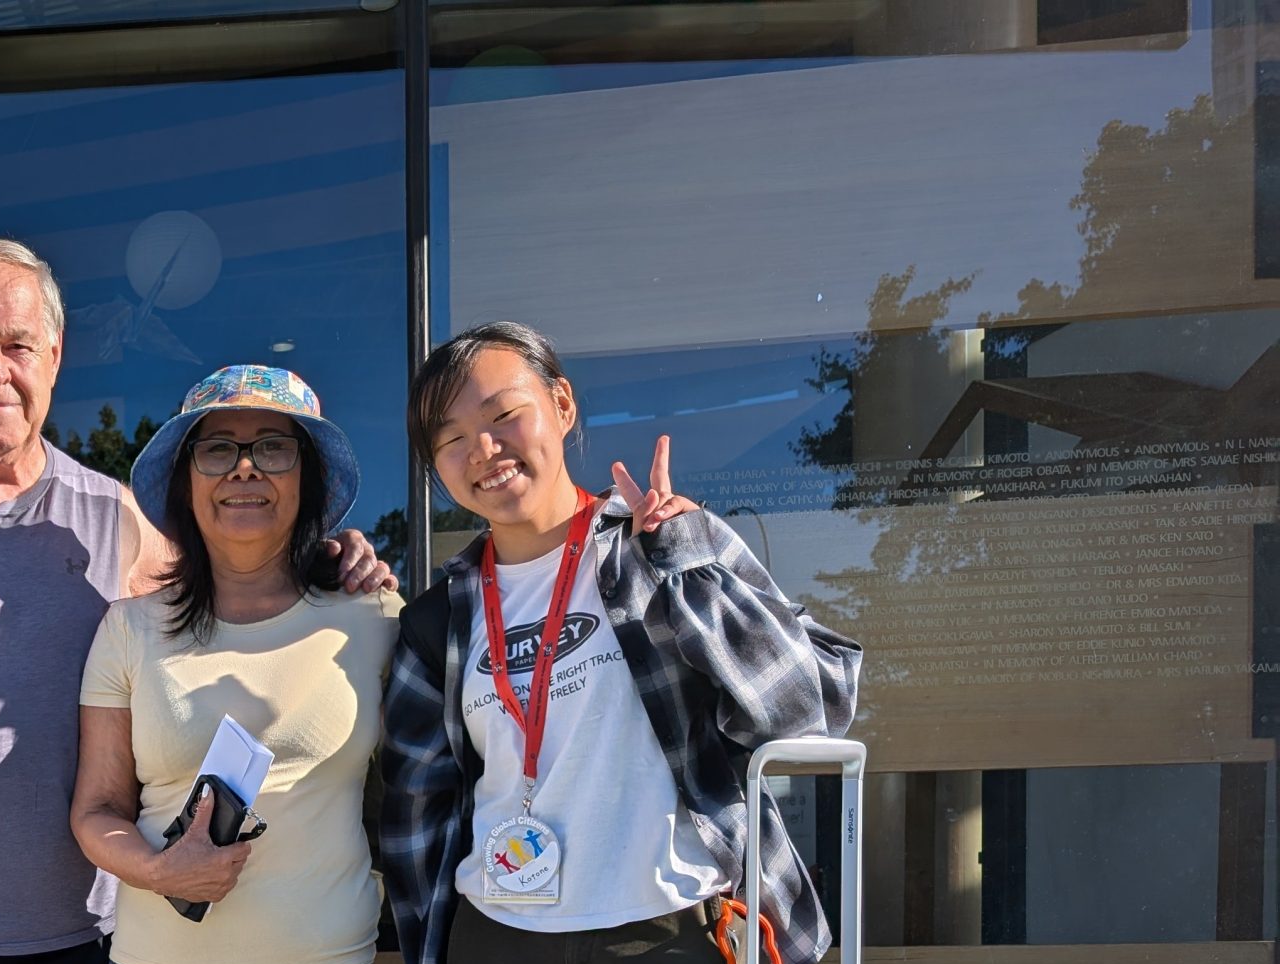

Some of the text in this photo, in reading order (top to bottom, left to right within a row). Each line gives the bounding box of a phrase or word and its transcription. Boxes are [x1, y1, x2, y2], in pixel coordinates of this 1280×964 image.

[894, 437, 1246, 471] DENNIS KIMOTO ANONYMOUS ANONYMOUS N L
[718, 484, 730, 496] IN
[732, 481, 778, 495] MEMORY
[782, 480, 796, 492] OF
[912, 472, 924, 484] IN
[926, 469, 974, 483] MEMORY
[978, 468, 992, 480] OF
[996, 465, 1032, 479] ROGER
[1036, 463, 1072, 476] OBATA
[1086, 461, 1096, 473] IN
[1100, 458, 1148, 472] MEMORY
[1152, 457, 1168, 469] OF
[1172, 455, 1196, 468] MRS
[1200, 453, 1240, 466] SAWAE
[766, 471, 1192, 507] & MAKIHARA HIROSHI & MAKIHARA FUKUMI ITO SHANAHAN
[1150, 482, 1254, 499] MIYAMOTO (IKEDA)
[1028, 499, 1232, 521] NAGANO JEANNETTE
[1088, 514, 1222, 532] AKASAKI TAK & SADIE
[1096, 529, 1214, 546] MR & MRS KEN SATO
[1072, 544, 1224, 562] HARAGA JANICE HOYANO
[982, 563, 1132, 581] KAZUYE YOSHIDA TERUKO
[1106, 574, 1212, 590] DR & MRS EDWARD
[1114, 593, 1148, 604] KUDO
[988, 612, 1050, 625] IN MEMORY
[1008, 620, 1190, 638] SHARON YAMAMOTO & BILL SUMI
[990, 634, 1216, 654] IN MEMORY OF EDDIE YAMAMOTO
[982, 649, 1202, 669] IN MEMORY OF ALFRED WILLIAM CHARD
[475, 689, 502, 712] ALON
[556, 659, 589, 685] RIGHT
[589, 649, 625, 671] TRAC
[1156, 665, 1180, 678] MRS
[549, 676, 588, 703] FREELY
[485, 816, 550, 874] Growing Global Citizens
